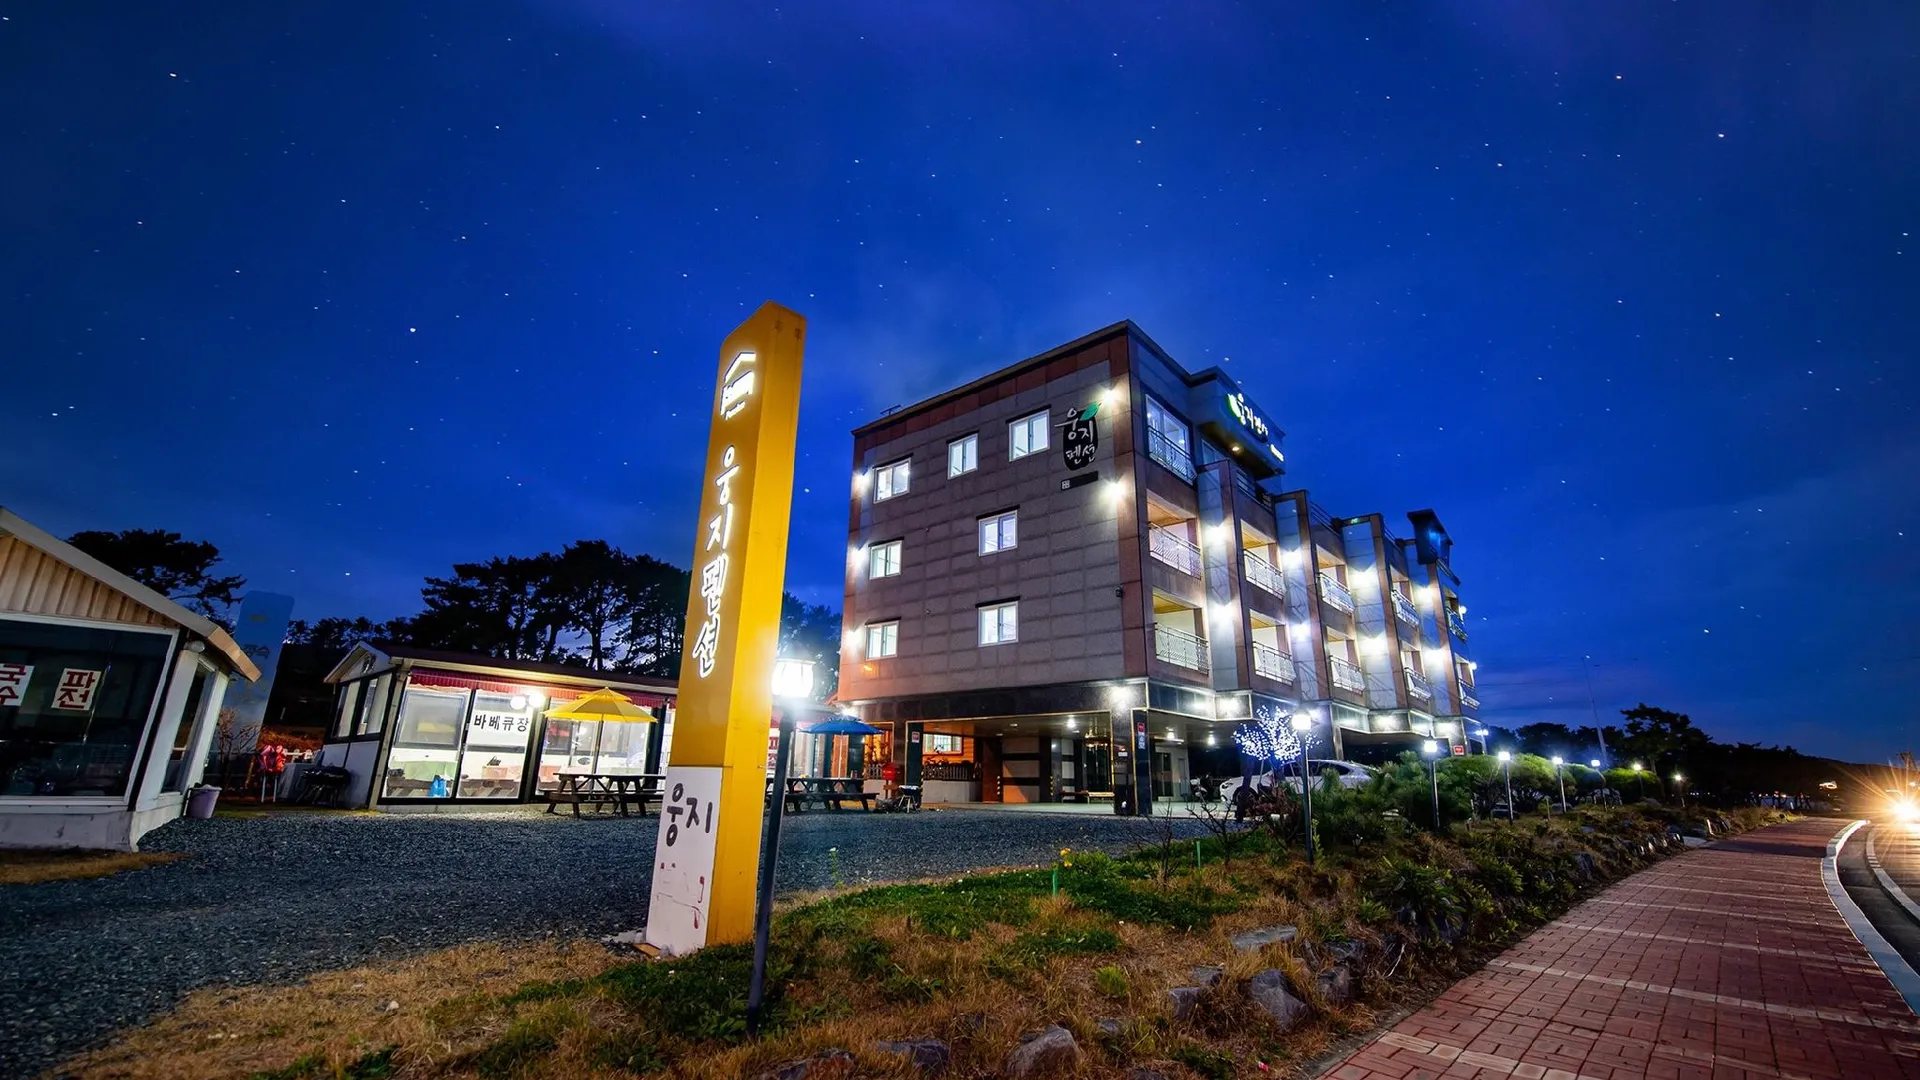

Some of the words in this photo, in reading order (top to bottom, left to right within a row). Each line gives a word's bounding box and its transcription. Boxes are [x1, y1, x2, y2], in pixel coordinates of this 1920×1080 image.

[1054, 407, 1095, 443] 웅지
[1065, 444, 1095, 465] 펜션
[692, 444, 740, 678] 웅지펜션
[0, 663, 26, 704] 국수
[57, 670, 96, 709] 파전
[474, 714, 529, 732] 바베큐장
[665, 786, 713, 847] 웅지
